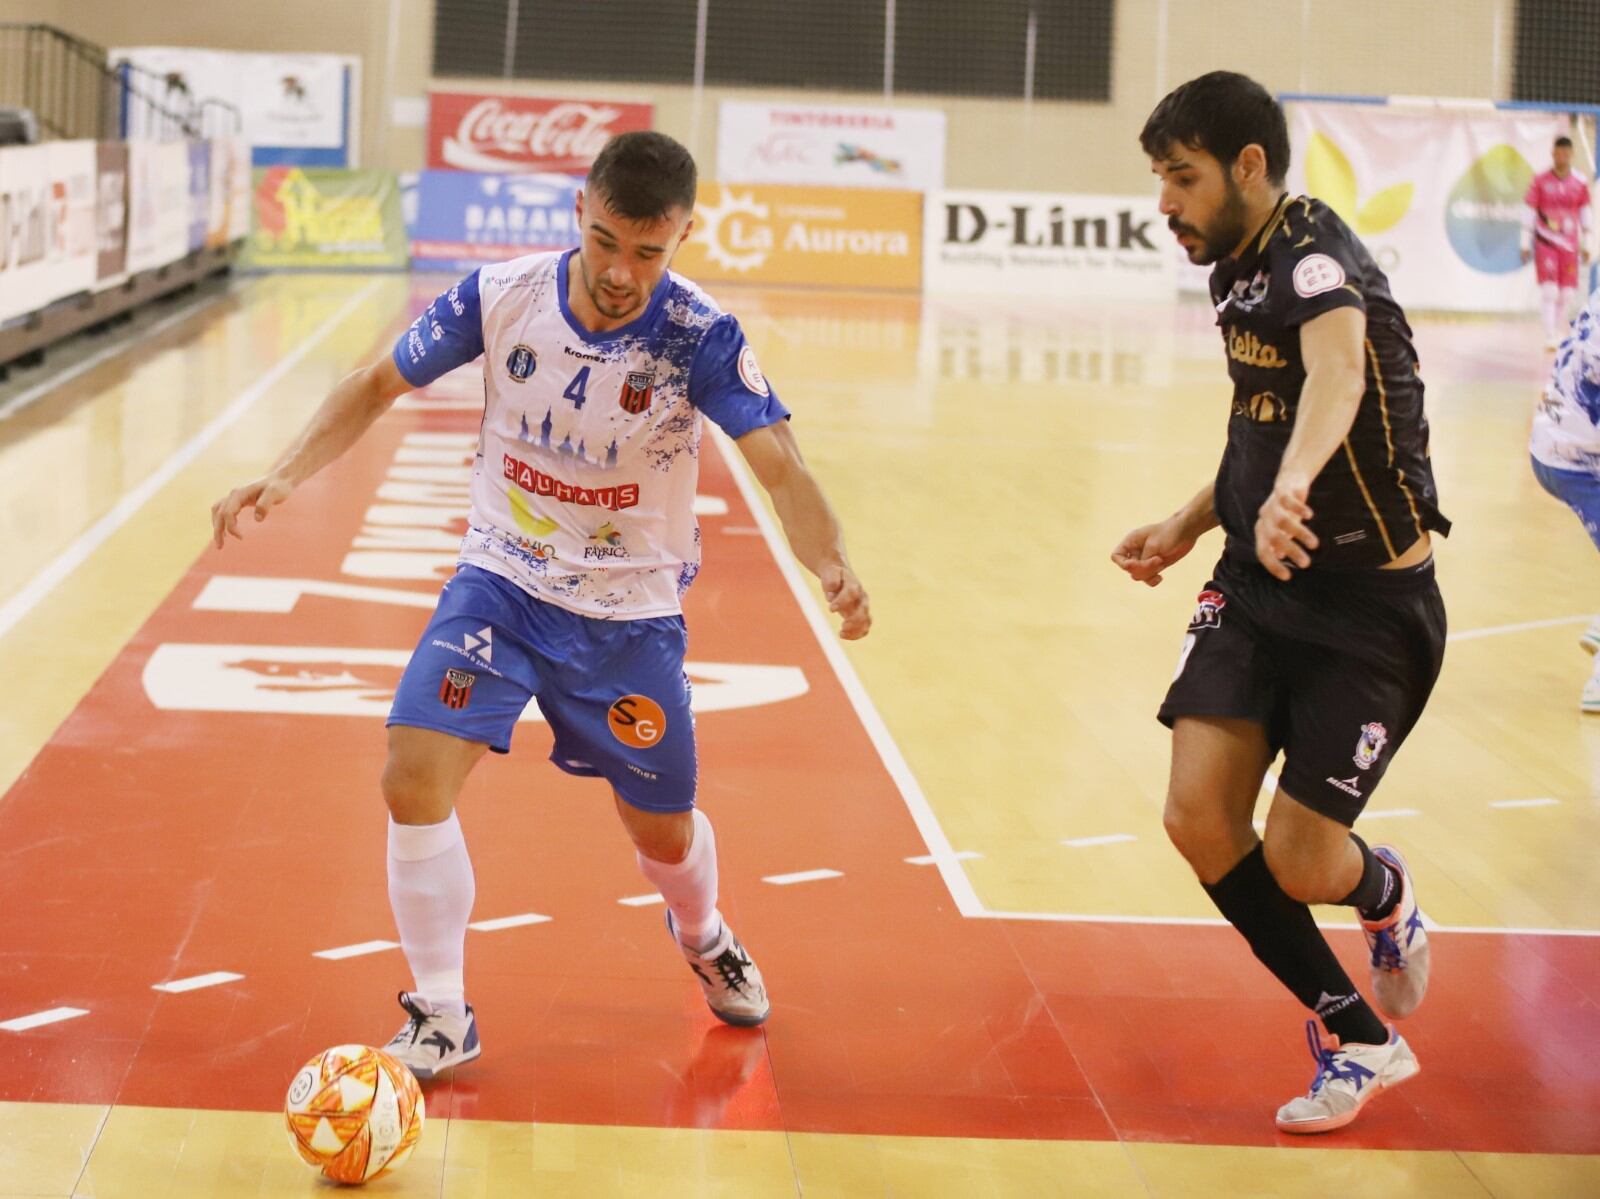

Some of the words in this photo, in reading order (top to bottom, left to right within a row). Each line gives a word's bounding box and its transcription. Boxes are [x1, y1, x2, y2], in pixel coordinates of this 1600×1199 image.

[730, 220, 773, 249] La
[784, 223, 909, 256] Aurora
[944, 203, 1159, 251] D-Link
[563, 346, 607, 364] Kromex
[562, 365, 591, 411] 4
[503, 454, 639, 511] BAUHAUS
